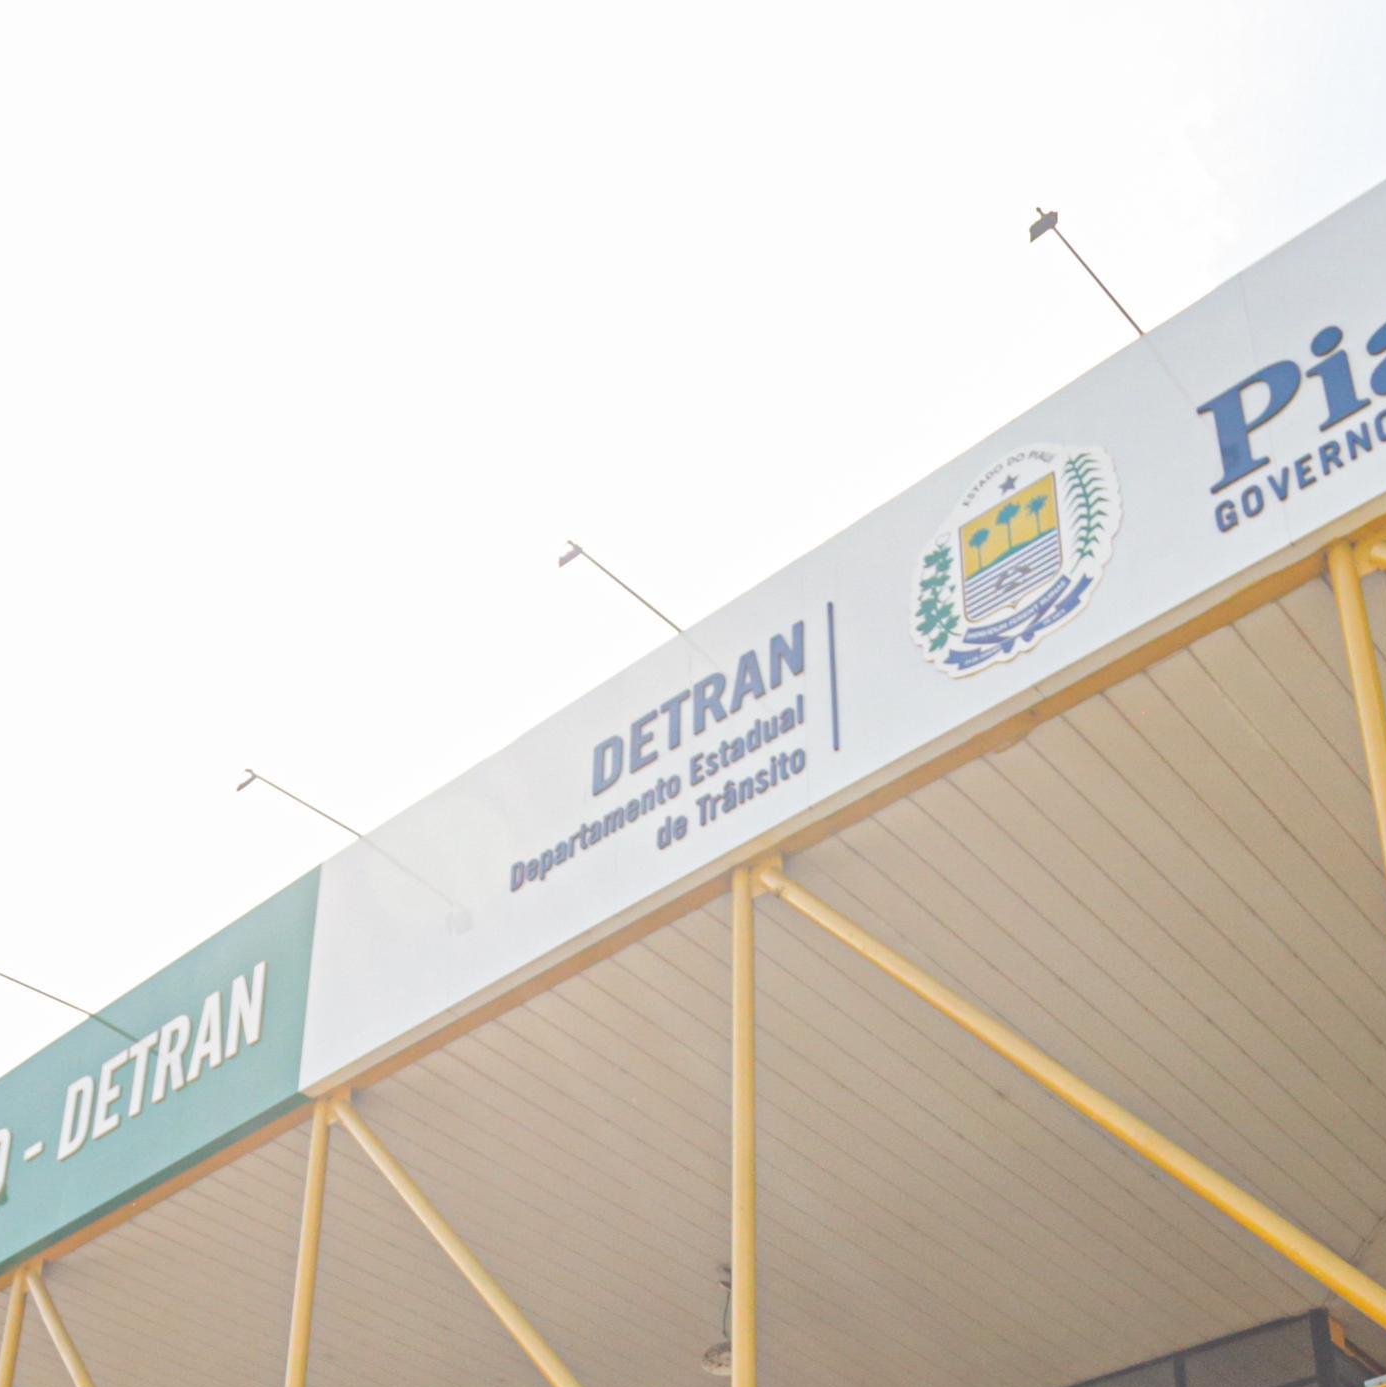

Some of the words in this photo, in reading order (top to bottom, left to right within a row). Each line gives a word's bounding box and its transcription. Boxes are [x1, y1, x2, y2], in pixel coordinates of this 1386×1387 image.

[510, 774, 681, 893] Departamento
[689, 693, 804, 787] Estadual
[592, 620, 805, 797] DETRAN
[656, 815, 688, 851] de
[695, 747, 806, 827] Trânsito
[57, 960, 266, 1162] DETRAN
